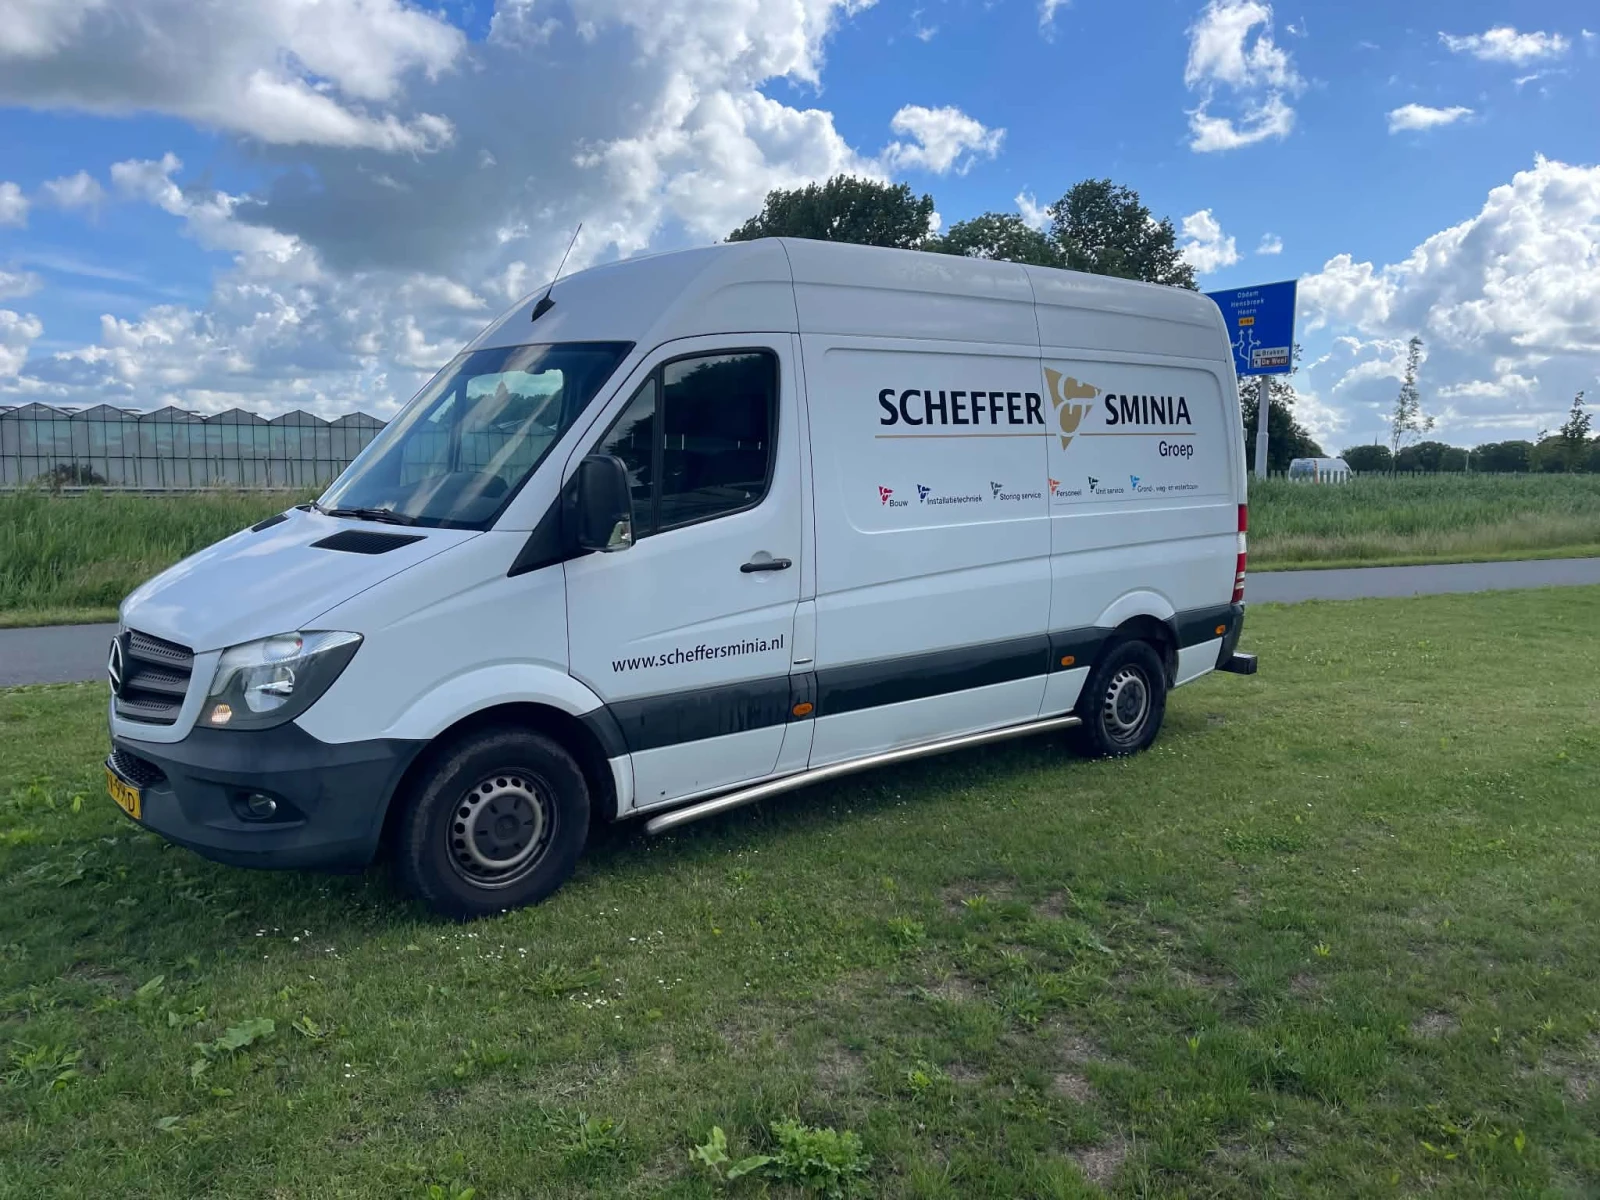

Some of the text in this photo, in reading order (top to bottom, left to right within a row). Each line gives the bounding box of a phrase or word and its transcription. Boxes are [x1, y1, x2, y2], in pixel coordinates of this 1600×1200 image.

[879, 388, 1045, 426] SCHEFFER
[1105, 393, 1192, 426] SMINIA
[1158, 440, 1194, 460] Groep
[999, 491, 1041, 501] Storing service
[1056, 489, 1082, 497] Personeel
[889, 499, 909, 507] Bouw
[927, 494, 982, 505] Installatietechniek
[612, 633, 784, 673] www.scheffersminia.nl
